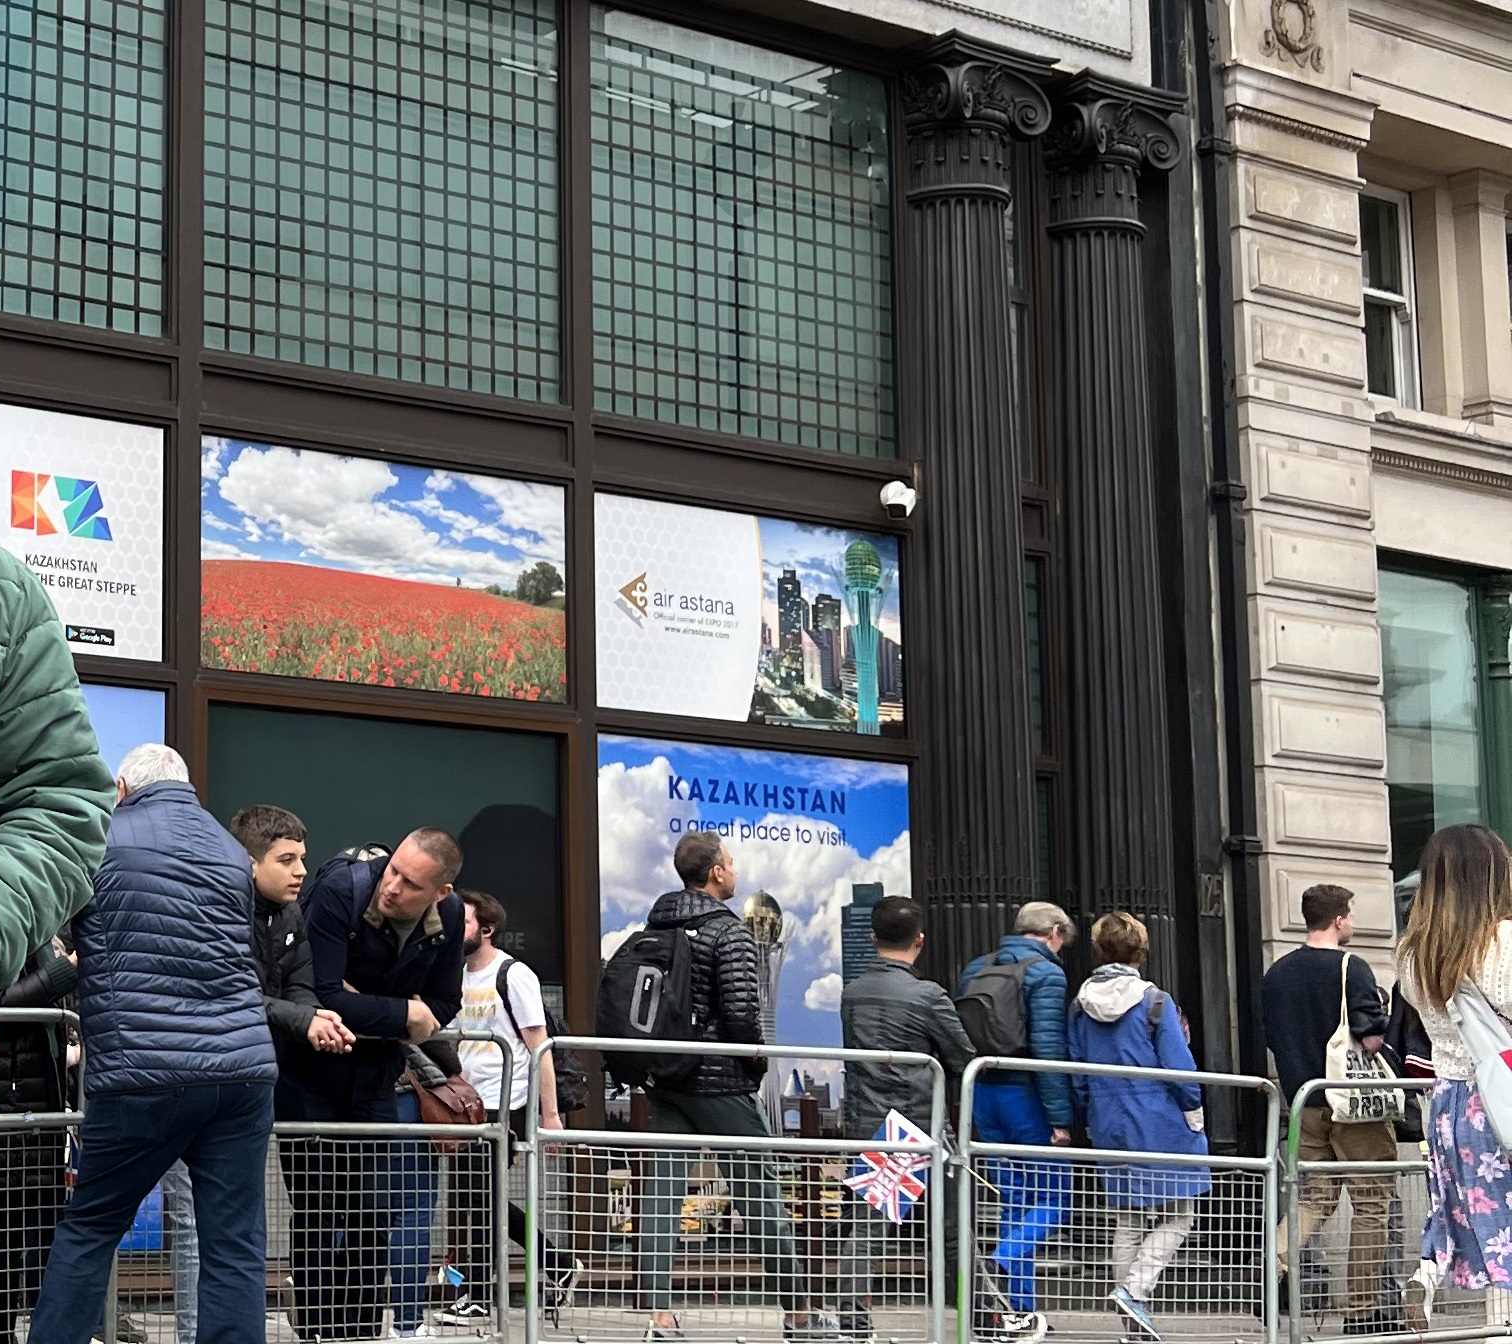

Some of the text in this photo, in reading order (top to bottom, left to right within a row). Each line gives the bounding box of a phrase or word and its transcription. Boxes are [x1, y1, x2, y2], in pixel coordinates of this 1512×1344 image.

[10, 469, 114, 542] KZ
[25, 552, 98, 574] KAZAKHSTAN
[57, 575, 94, 591] GREAT
[95, 579, 137, 596] STEPPE
[653, 588, 735, 616] air astana
[668, 775, 846, 815] KAZAKHSTAN
[669, 818, 682, 833] a
[740, 821, 791, 843] place
[796, 824, 812, 844] to
